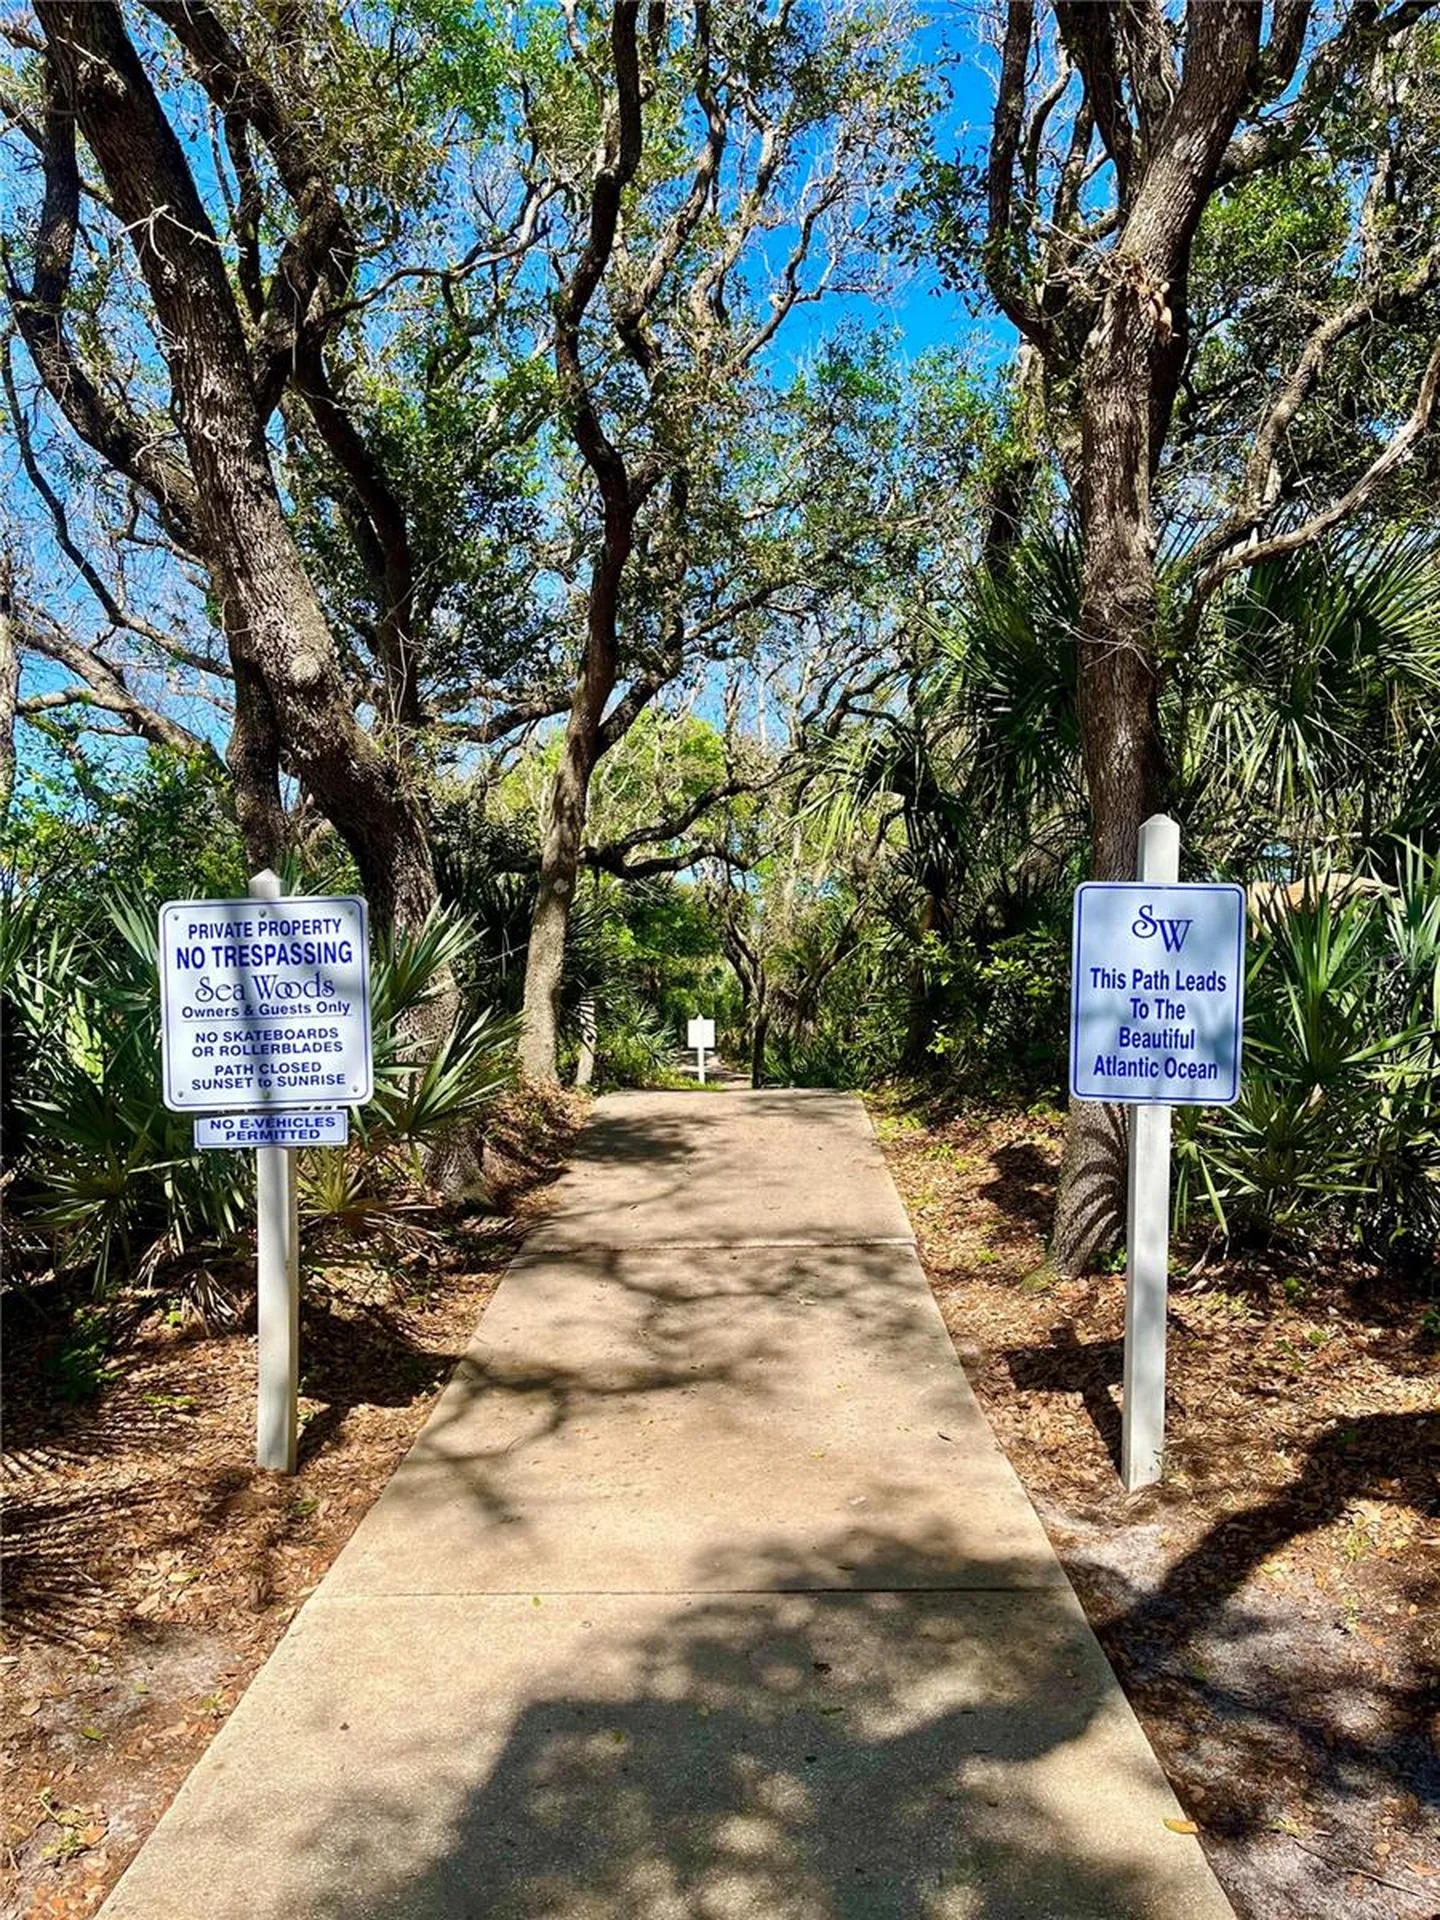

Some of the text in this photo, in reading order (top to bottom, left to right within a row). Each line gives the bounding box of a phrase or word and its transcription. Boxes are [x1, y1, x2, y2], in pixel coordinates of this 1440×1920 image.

[188, 919, 341, 939] PRIVATE PROPERTY
[1132, 904, 1193, 953] SW
[177, 941, 352, 969] NO TRESPASSING
[195, 971, 335, 1002] Sea Woods
[1090, 968, 1226, 991] This Path Leads
[182, 1001, 350, 1018] Owners & Guests Only
[1130, 998, 1185, 1019] To The
[196, 1028, 339, 1043] NO SKATEBOARDS
[1119, 1027, 1195, 1049] Beautiful
[192, 1041, 343, 1057] OR ROLLERBLADES
[215, 1062, 322, 1075] PATH CLOSED
[1093, 1055, 1217, 1079] Atlantic Ocean
[192, 1074, 345, 1090] SUNSET to SUNRISE
[210, 1117, 335, 1129] NO E-VEHICLES
[226, 1129, 320, 1140] PERMITTED
